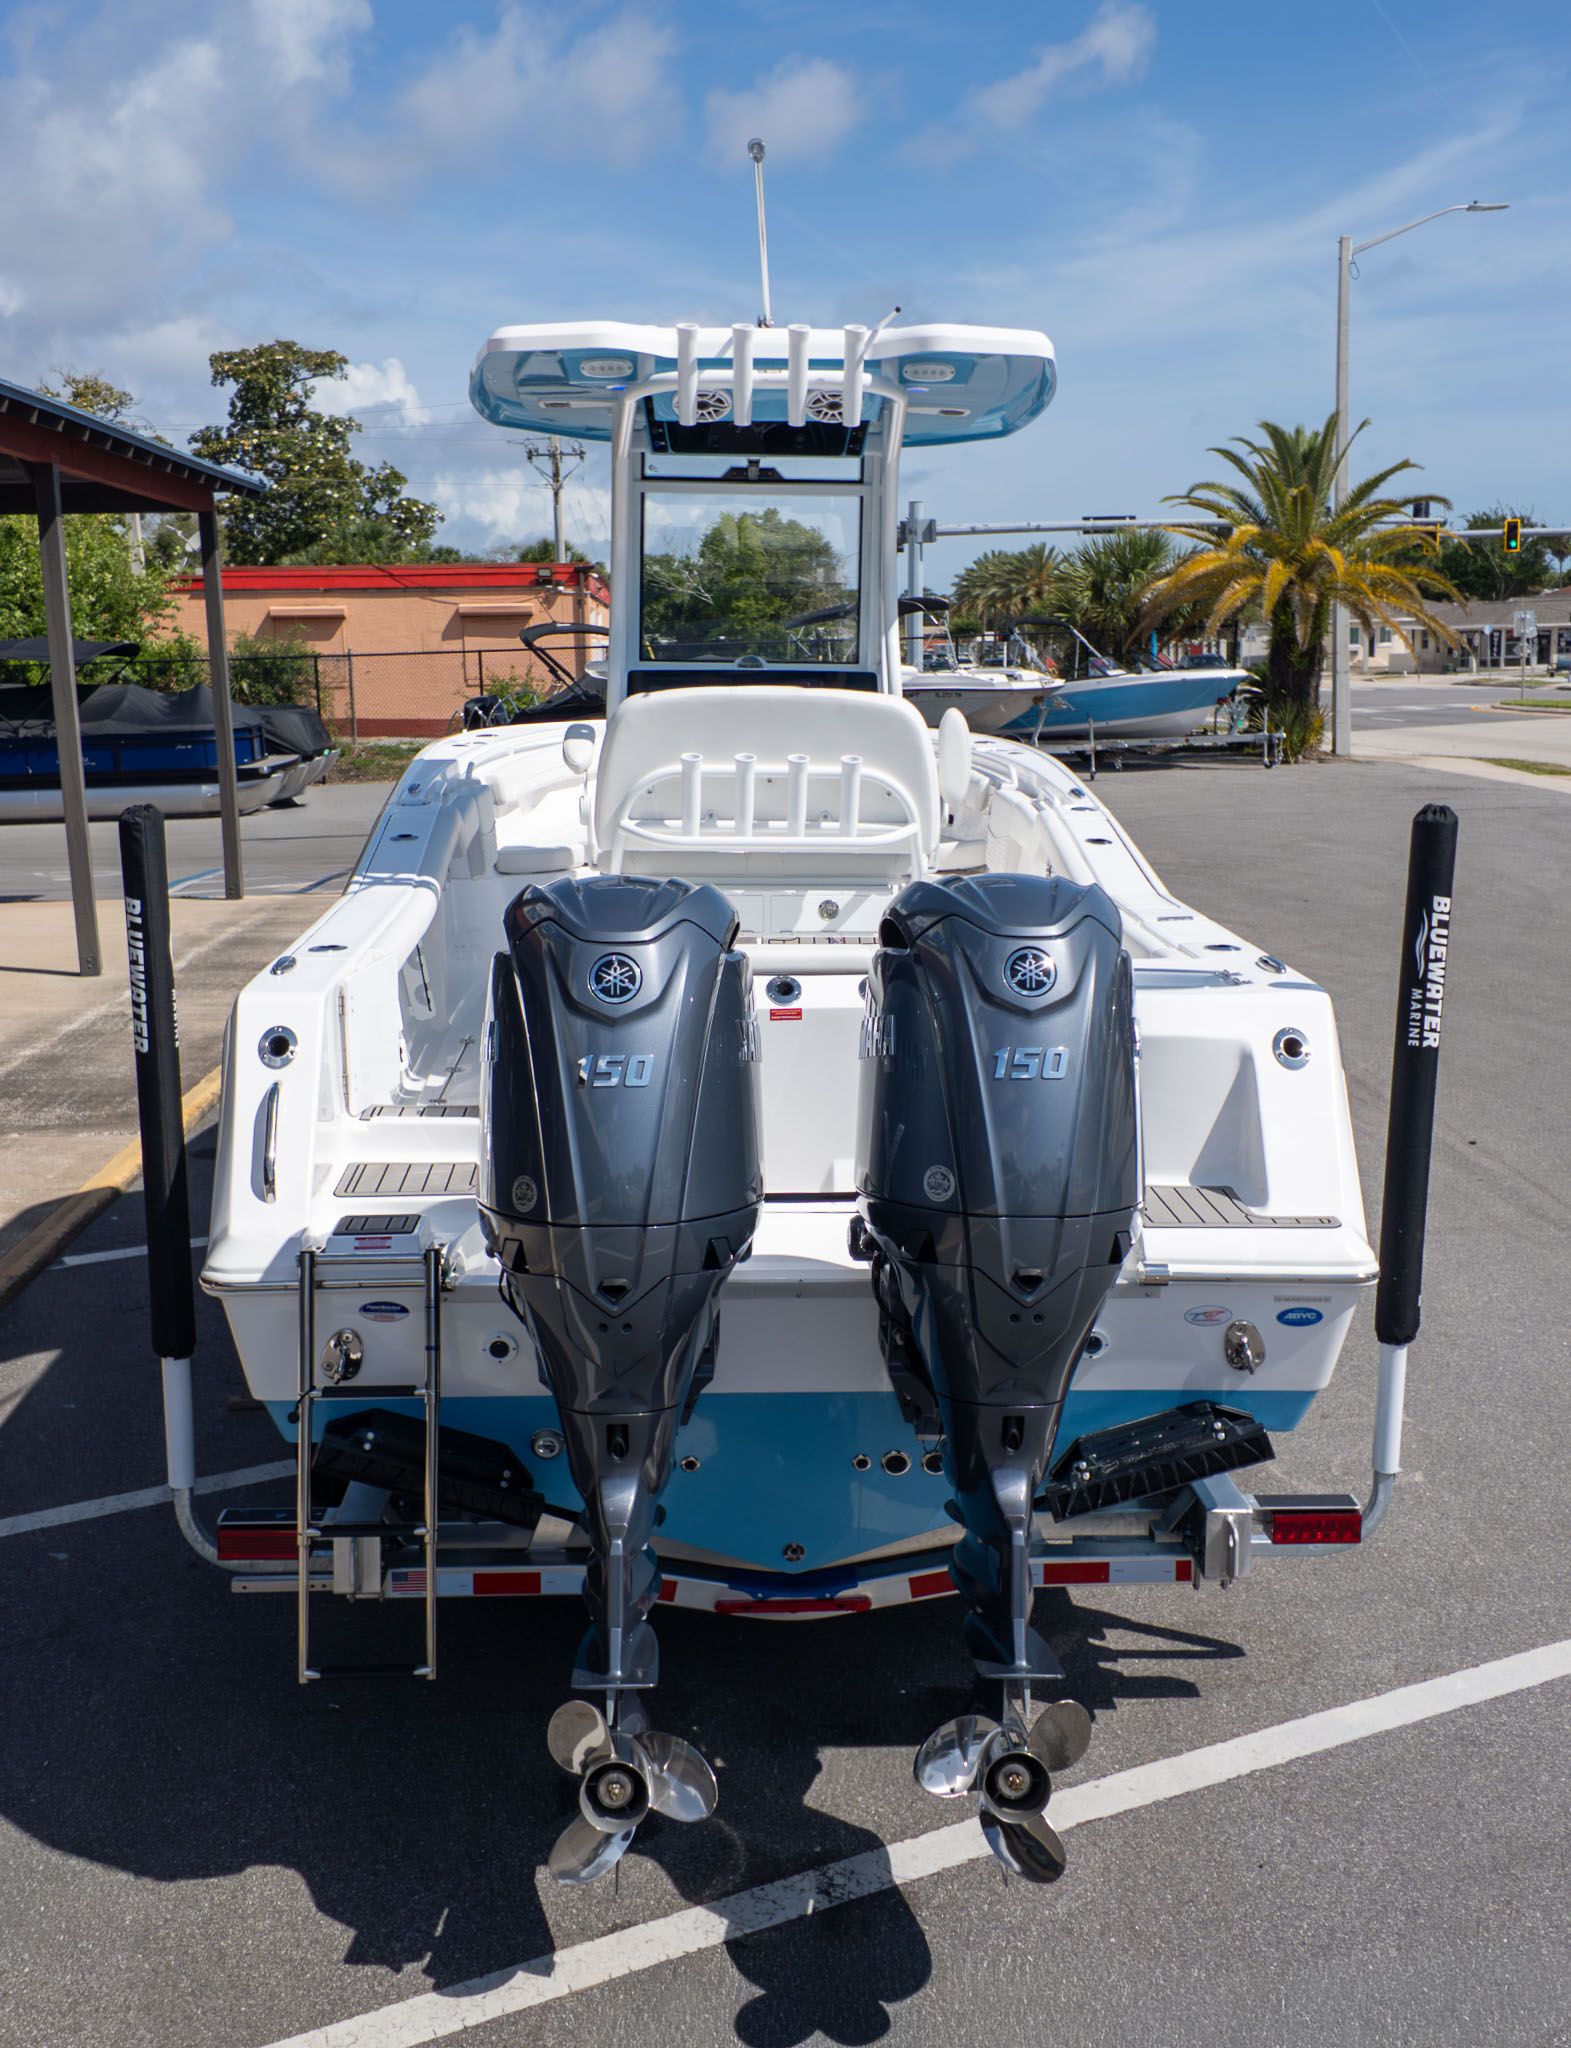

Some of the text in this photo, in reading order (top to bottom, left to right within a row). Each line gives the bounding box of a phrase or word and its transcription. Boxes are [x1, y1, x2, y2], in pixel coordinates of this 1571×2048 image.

[125, 896, 149, 1054] BLUEWATER
[1422, 895, 1451, 1048] BLUEWATER
[1408, 988, 1423, 1047] MARINE
[577, 1054, 654, 1087] 150
[994, 1046, 1070, 1079] 150
